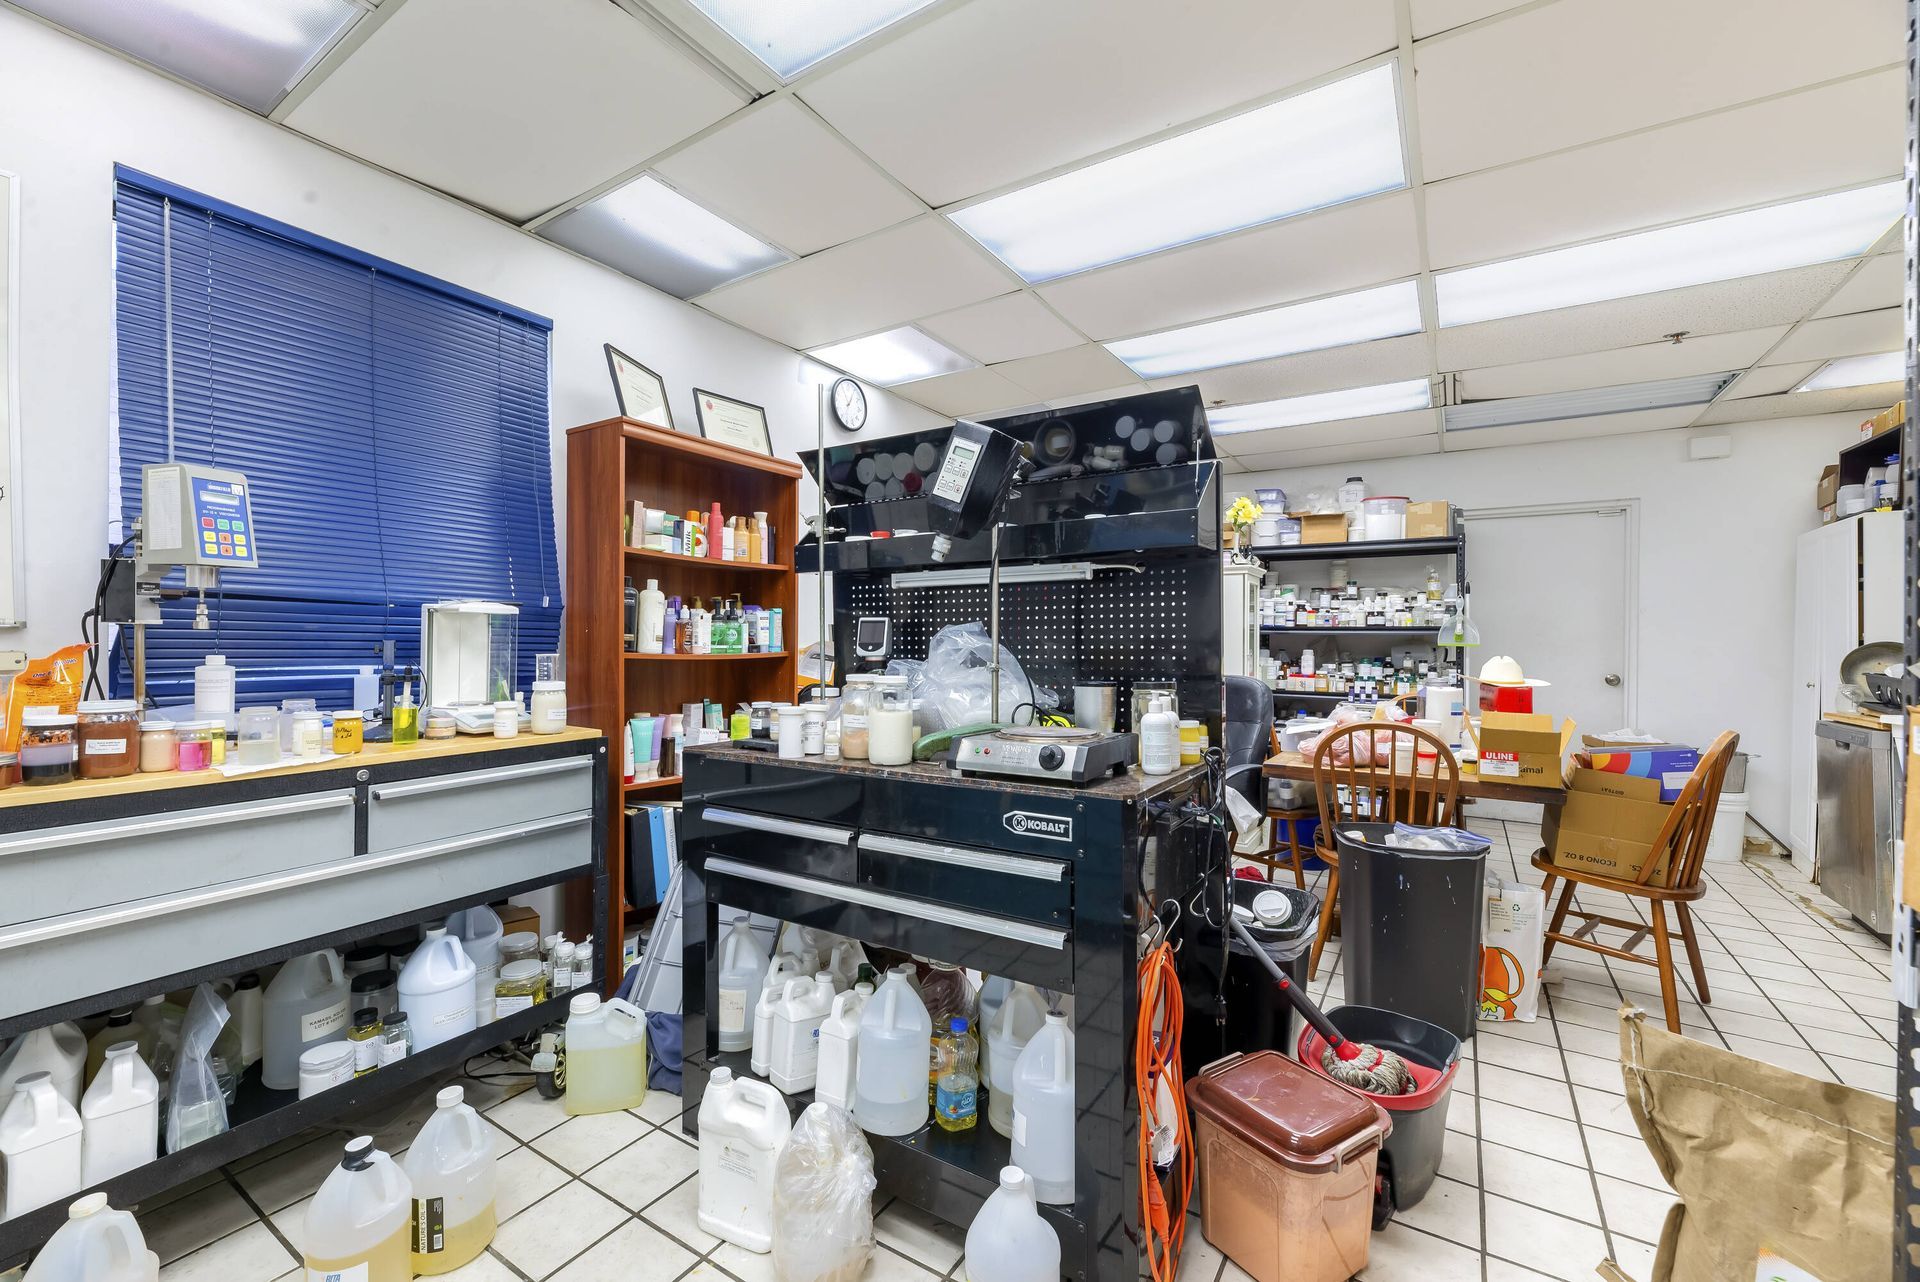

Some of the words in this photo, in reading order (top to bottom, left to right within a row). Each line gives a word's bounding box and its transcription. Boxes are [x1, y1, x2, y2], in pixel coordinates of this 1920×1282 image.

[1485, 751, 1514, 761] ULINE
[1519, 766, 1544, 774] amal
[1028, 819, 1066, 833] KOBALT
[1586, 856, 1617, 867] ECONO
[314, 1022, 325, 1030] LOT
